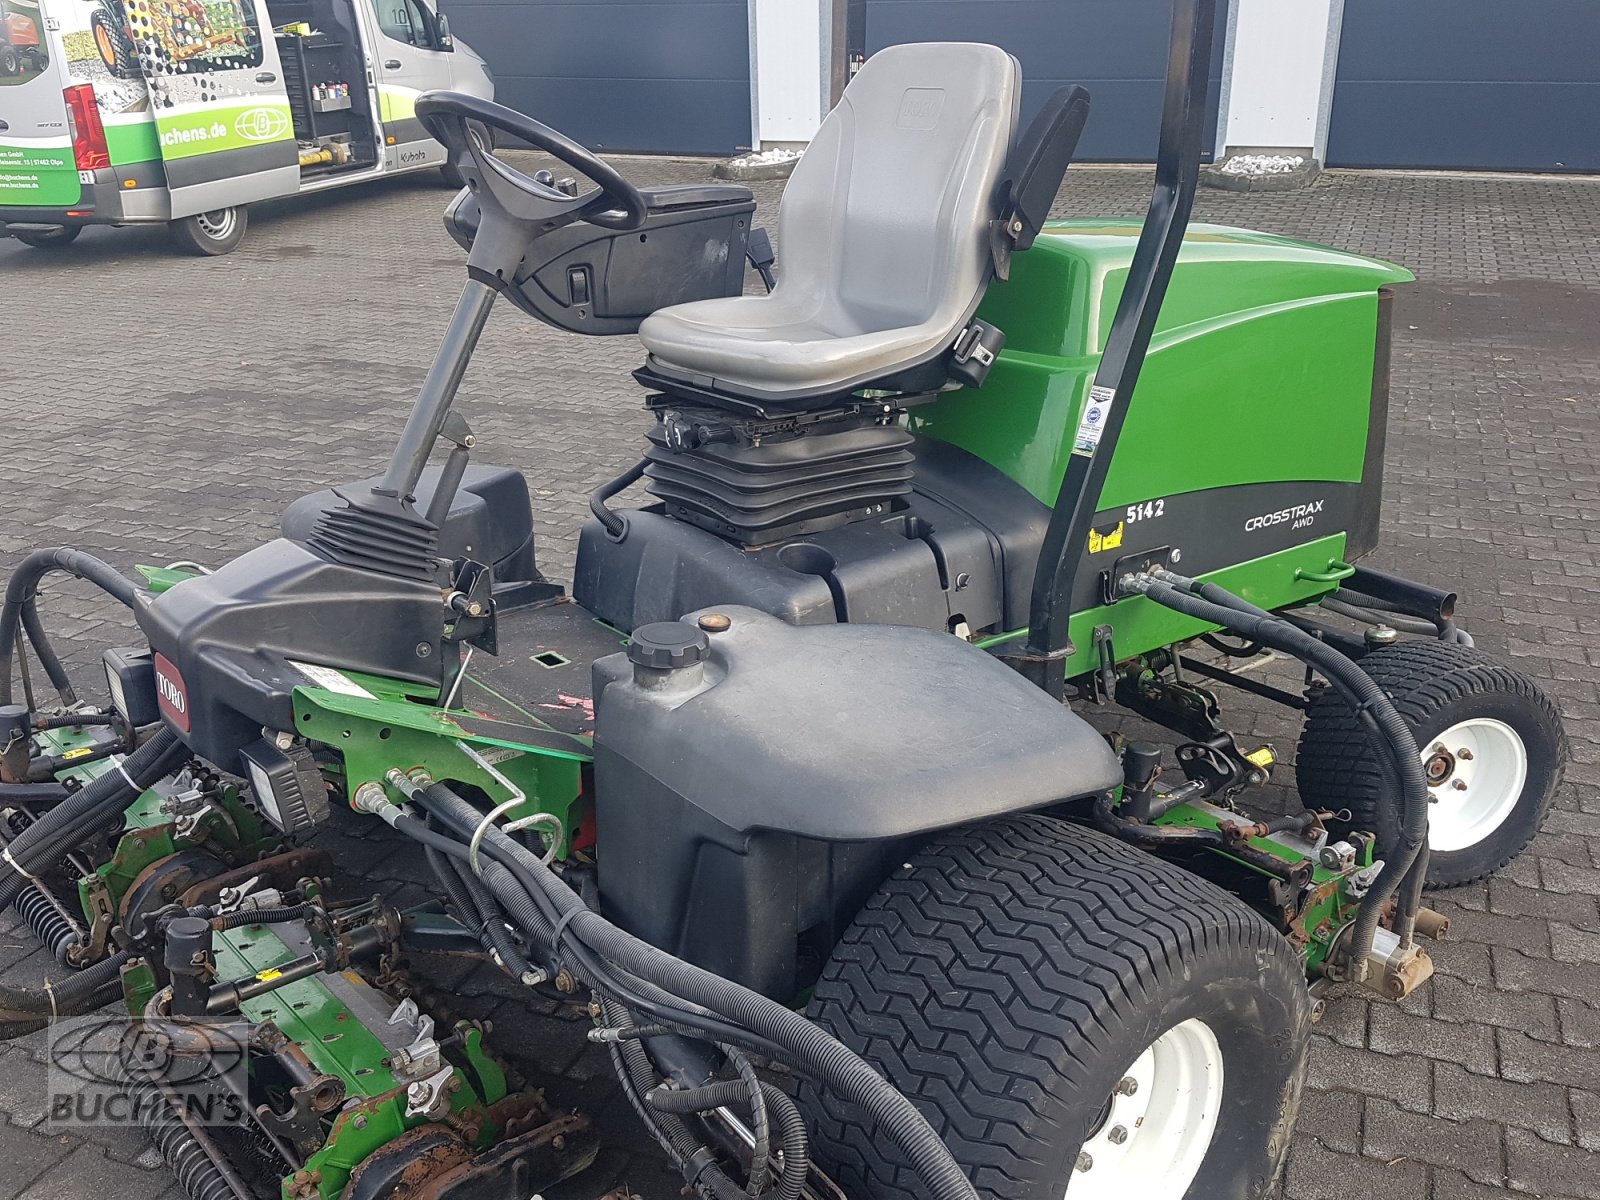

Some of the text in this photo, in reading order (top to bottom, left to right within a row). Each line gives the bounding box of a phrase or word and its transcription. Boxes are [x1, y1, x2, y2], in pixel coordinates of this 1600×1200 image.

[391, 8, 408, 25] 10
[400, 150, 426, 162] Kubota
[1126, 499, 1165, 524] 5142
[1244, 499, 1325, 532] CROSSTRAX
[1291, 516, 1314, 531] AWD
[157, 671, 185, 714] TORO
